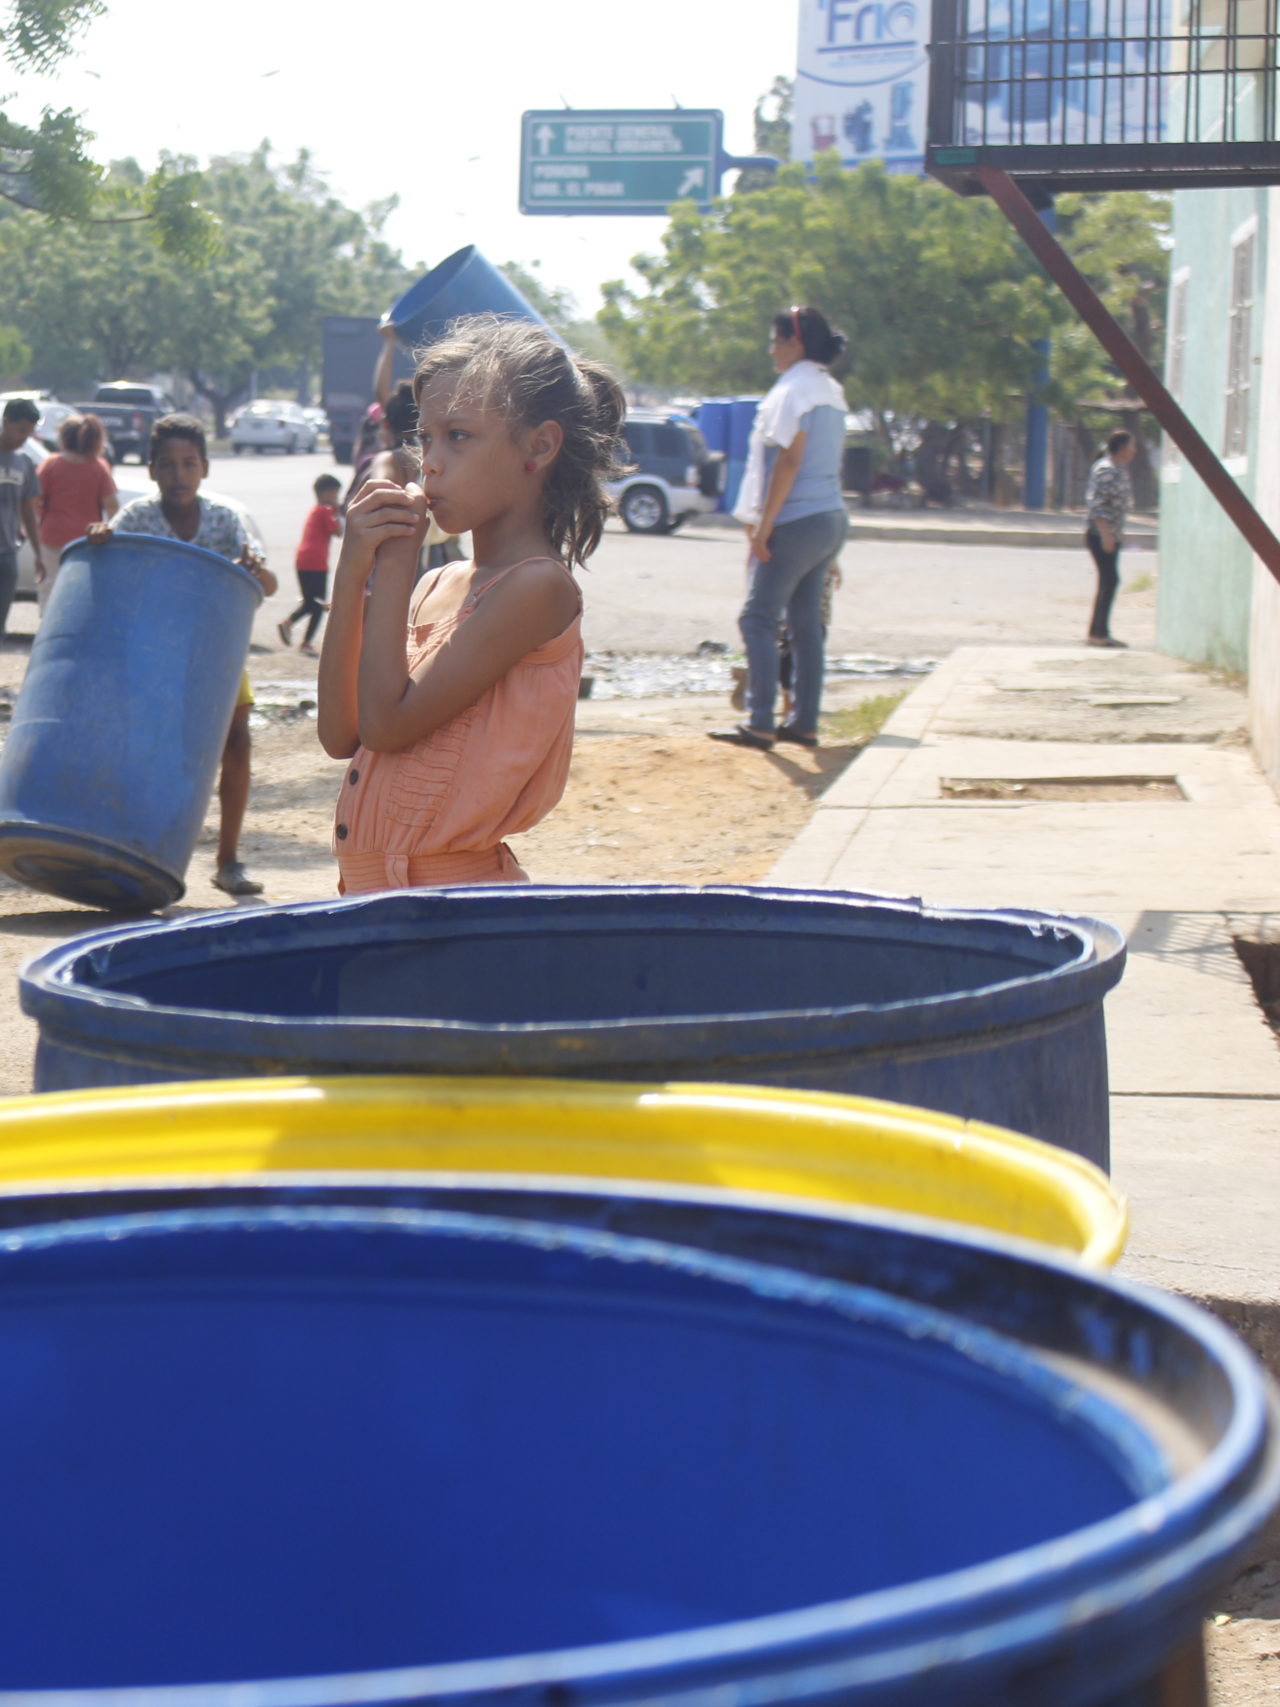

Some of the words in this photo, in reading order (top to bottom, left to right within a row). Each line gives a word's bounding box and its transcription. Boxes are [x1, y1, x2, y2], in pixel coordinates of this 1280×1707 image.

[566, 126, 612, 139] PUENTE
[618, 126, 674, 139] GENERAL
[566, 140, 612, 153] RAFAEL
[566, 182, 581, 196] EL
[585, 182, 625, 196] PINAR
